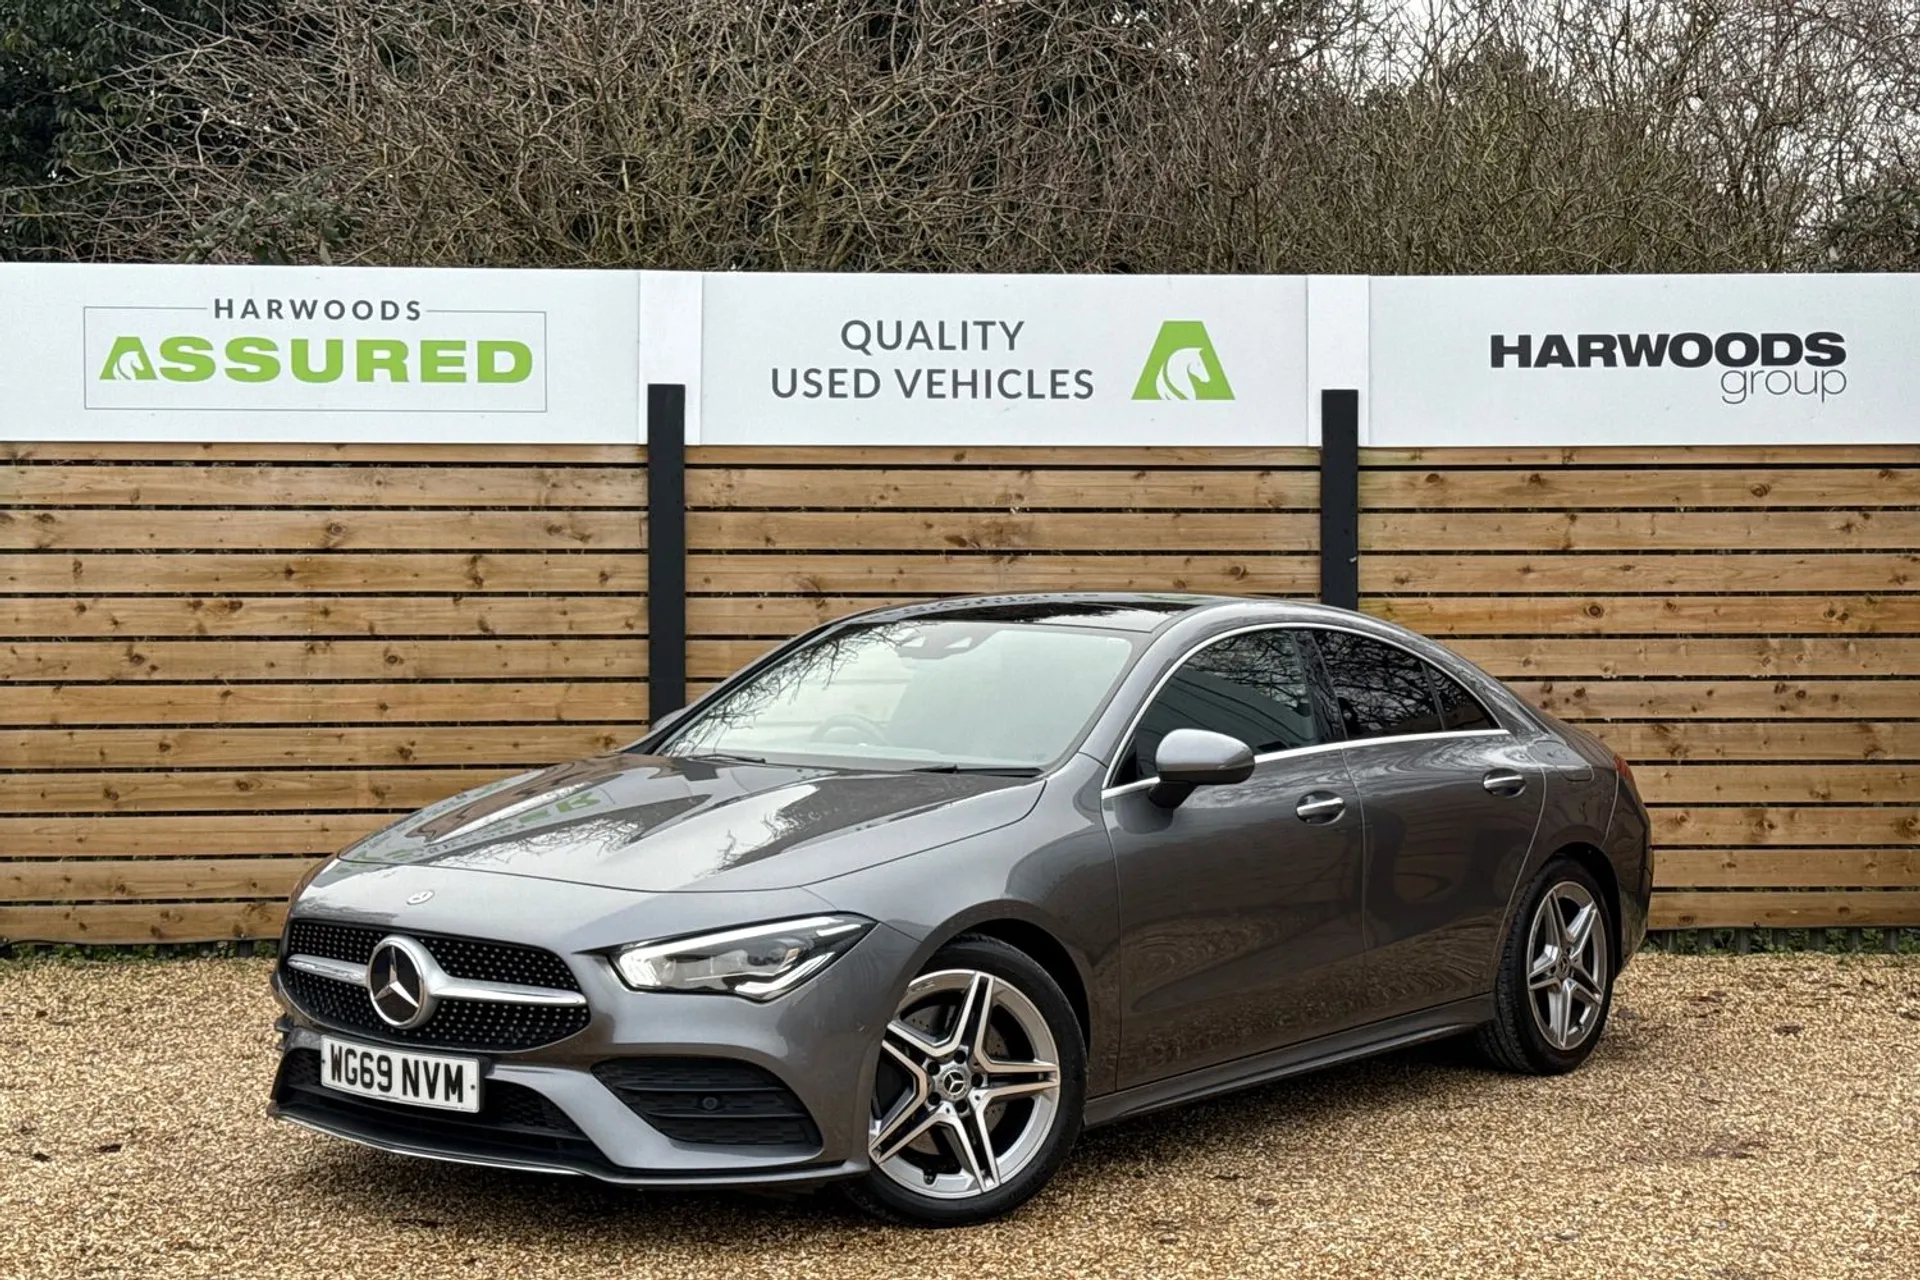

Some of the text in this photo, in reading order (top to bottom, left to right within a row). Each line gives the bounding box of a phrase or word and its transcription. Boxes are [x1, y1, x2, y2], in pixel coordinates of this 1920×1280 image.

[214, 298, 421, 321] HARWOODS
[841, 319, 1025, 355] QUALITY
[1490, 331, 1847, 368] HARWOODS
[99, 336, 533, 383] ASSURED
[771, 367, 1094, 400] USED VEHICLES
[1720, 369, 1847, 404] group
[330, 1043, 464, 1103] WG69 NVM
